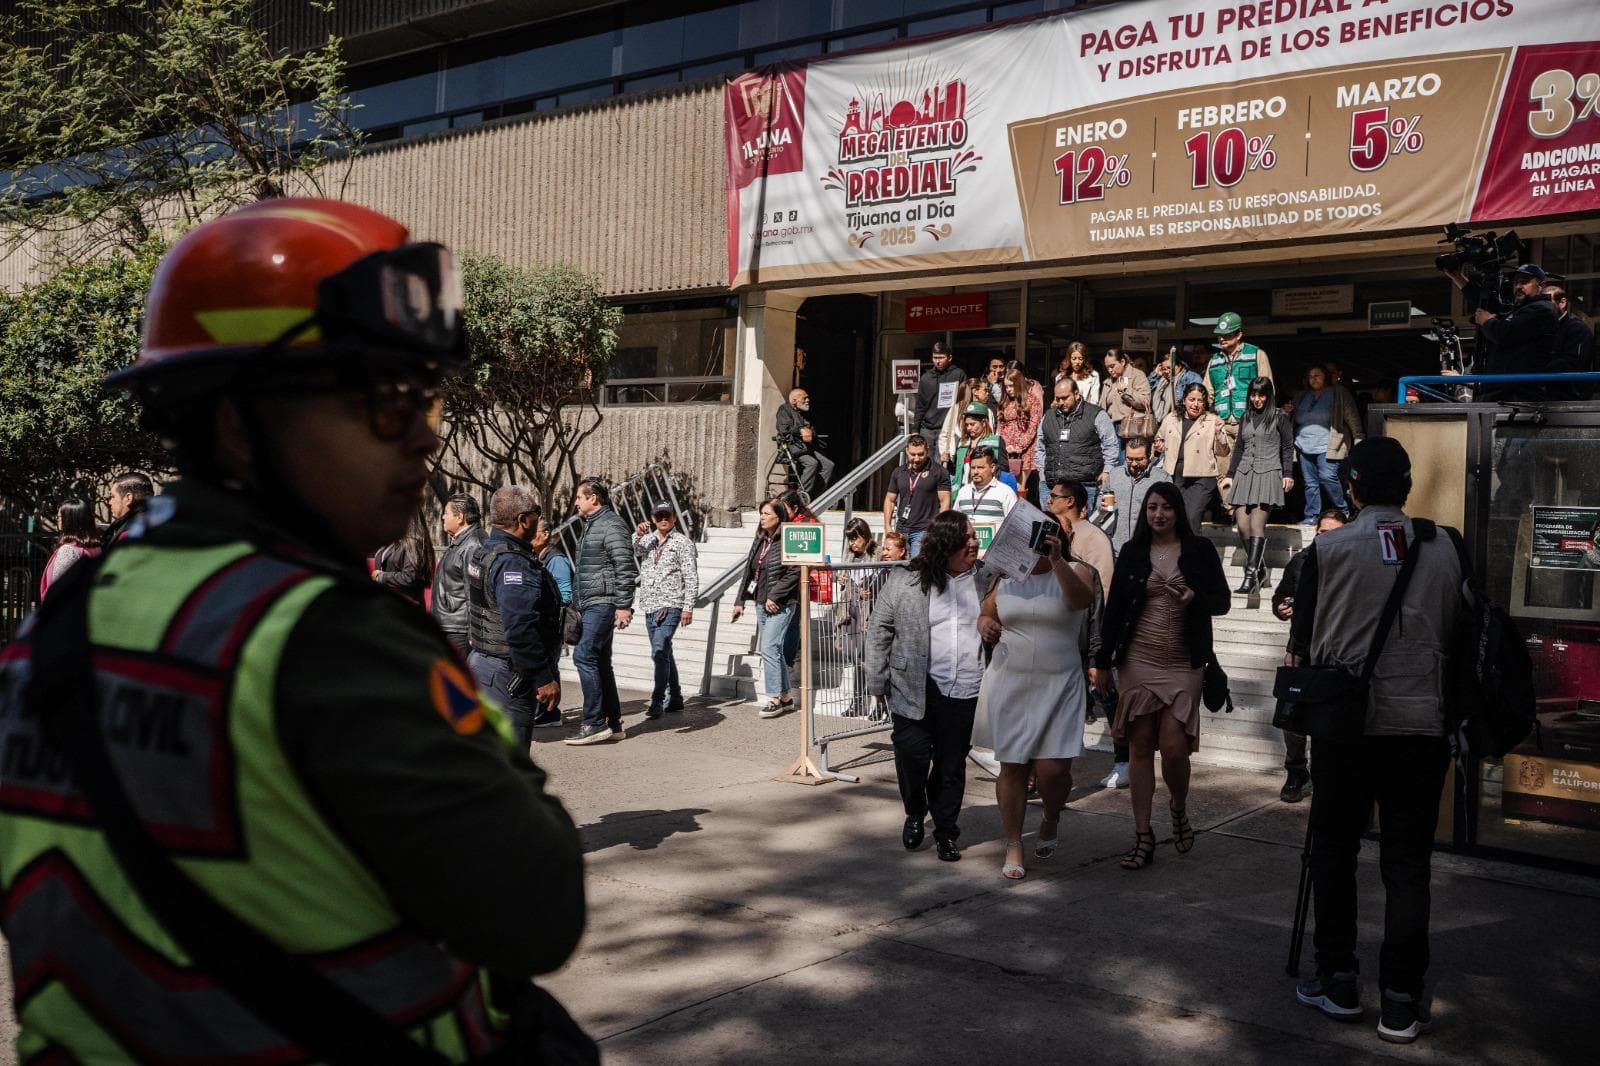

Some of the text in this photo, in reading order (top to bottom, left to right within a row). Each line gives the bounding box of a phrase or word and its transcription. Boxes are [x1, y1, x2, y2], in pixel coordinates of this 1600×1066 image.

[1080, 0, 1351, 57] PAGA TU PREDIAL
[1098, 0, 1514, 82] Y DISFRUTA DE LOS BENEFICIOS
[1336, 72, 1441, 109] MARZO
[1177, 95, 1287, 130] FEBRERO
[840, 120, 966, 161] MEGA EVENTO
[1055, 118, 1127, 147] ENERO
[1349, 106, 1424, 172] 5%
[889, 152, 908, 167] DEL
[1054, 146, 1131, 205] 12%
[1185, 127, 1276, 189] 10%
[1529, 163, 1600, 182] AL PAGAR
[847, 160, 955, 206] PREDIAL
[1533, 178, 1595, 197] EN LÍNEA
[846, 201, 955, 230] Tijuana al Día
[1090, 183, 1381, 224] PAGAR EL PREDIAL ES TU RESPONSABILIDAD.
[880, 226, 916, 246] 2025
[1089, 203, 1382, 241] TIJUANA ES RESPONSABILIDAD DE TODOS
[925, 303, 983, 316] BANORTE
[897, 369, 918, 378] SALIDA
[789, 531, 817, 542] ENTRADA
[1552, 768, 1580, 778] BAJA
